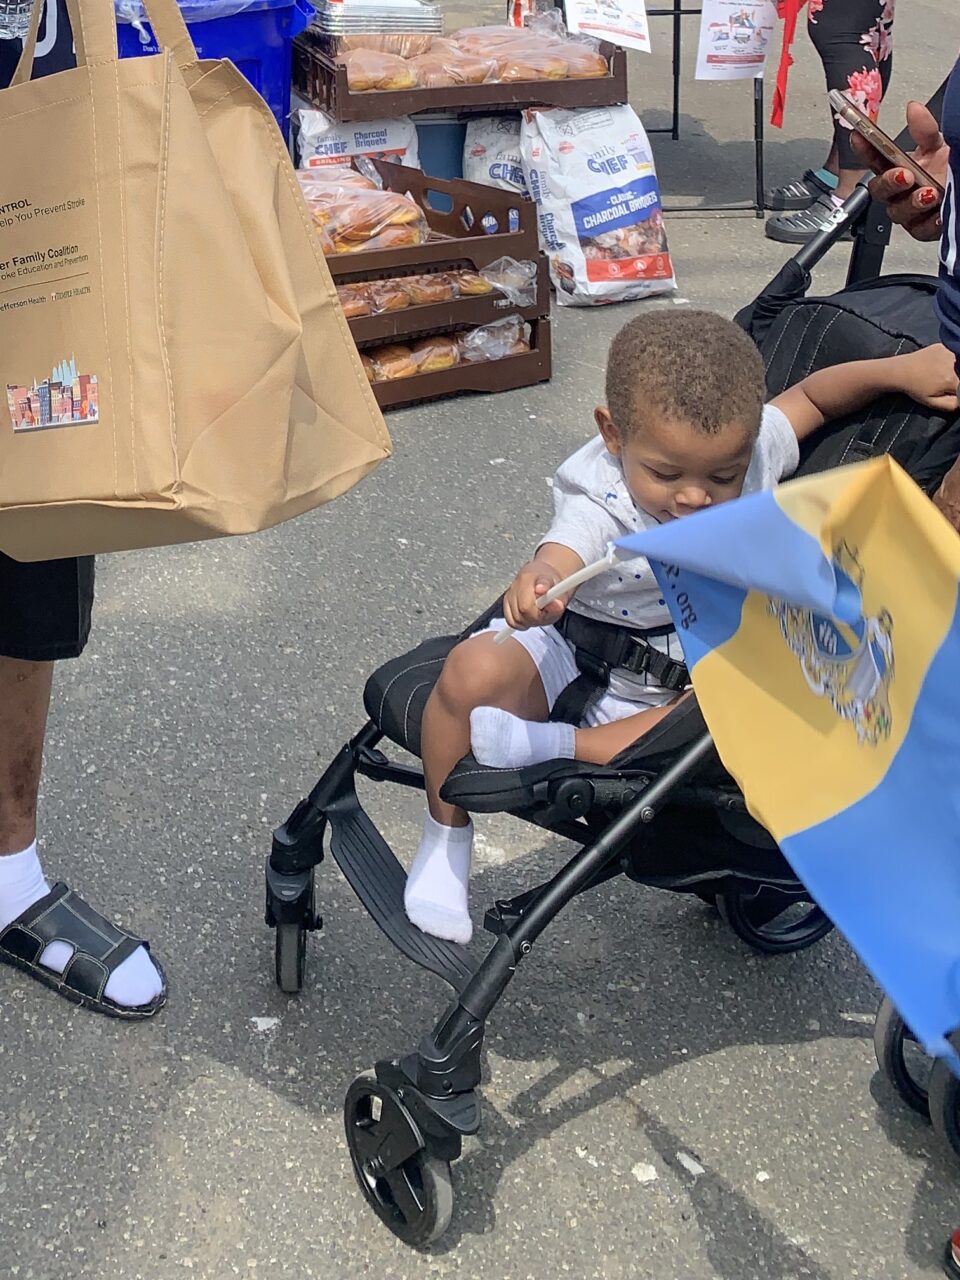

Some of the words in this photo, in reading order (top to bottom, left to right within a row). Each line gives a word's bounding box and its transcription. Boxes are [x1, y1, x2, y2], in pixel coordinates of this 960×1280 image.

[354, 128, 387, 140] Charcoal
[355, 137, 387, 148] Briquets
[315, 141, 348, 155] CHEF
[14, 211, 33, 222] You
[34, 203, 67, 217] Prevent
[67, 197, 86, 210] Stroke
[583, 203, 630, 229] CHARCOAL
[12, 251, 46, 267] Family
[47, 244, 79, 259] Coalition
[17, 262, 53, 276] Education
[53, 259, 64, 268] and
[64, 254, 89, 265] Prevention
[28, 295, 47, 305] Health
